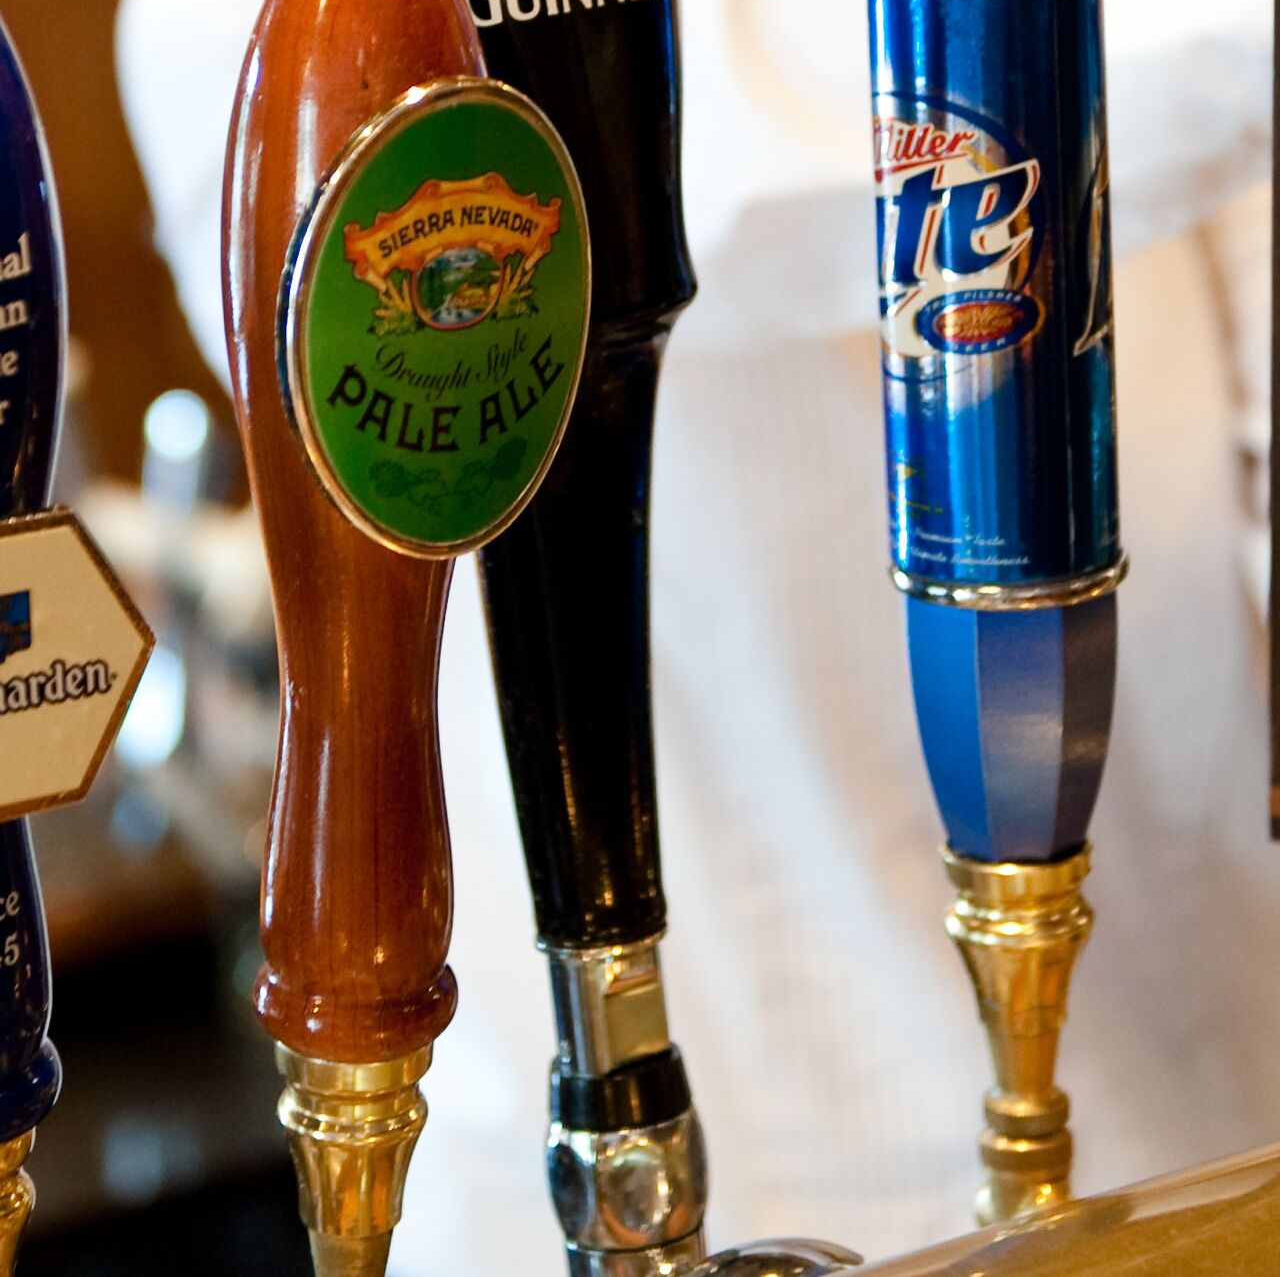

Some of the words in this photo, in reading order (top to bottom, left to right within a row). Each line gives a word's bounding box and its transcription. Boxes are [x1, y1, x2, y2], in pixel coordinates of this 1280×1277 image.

[378, 209, 455, 259] SIERRA
[460, 206, 534, 239] NEVADA
[326, 363, 462, 453] PALE
[478, 334, 566, 445] ALE
[375, 344, 470, 401] Draught
[475, 328, 527, 383] Style
